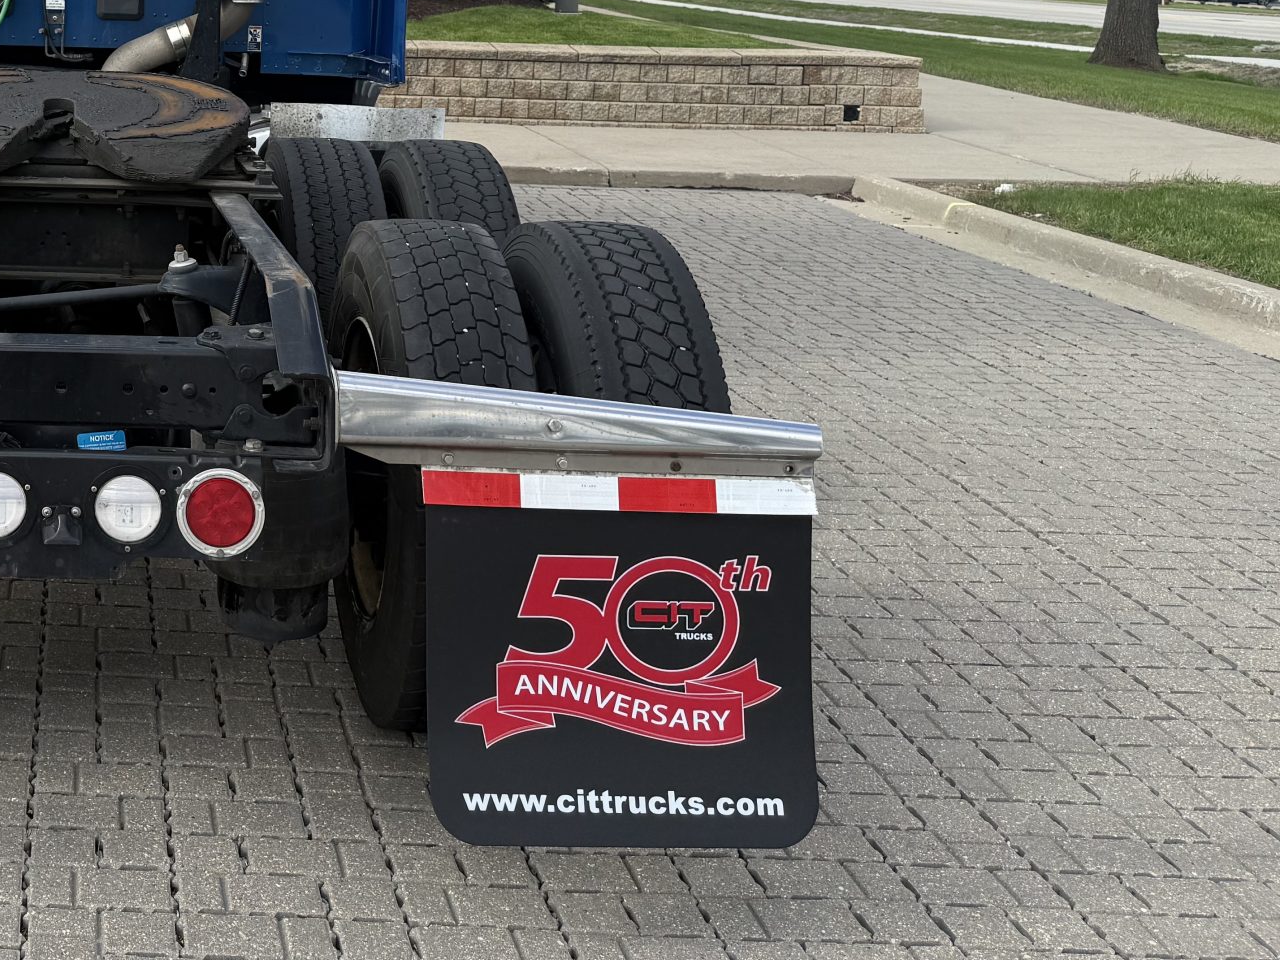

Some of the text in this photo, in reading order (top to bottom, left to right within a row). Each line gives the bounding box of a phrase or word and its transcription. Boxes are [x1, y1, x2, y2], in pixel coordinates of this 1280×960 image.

[90, 434, 114, 442] NOTICE
[627, 600, 715, 631] CIT
[674, 632, 714, 641] TRUCKS
[514, 674, 732, 732] ANNIVERSARY
[463, 789, 785, 816] www.cittrucks.com
